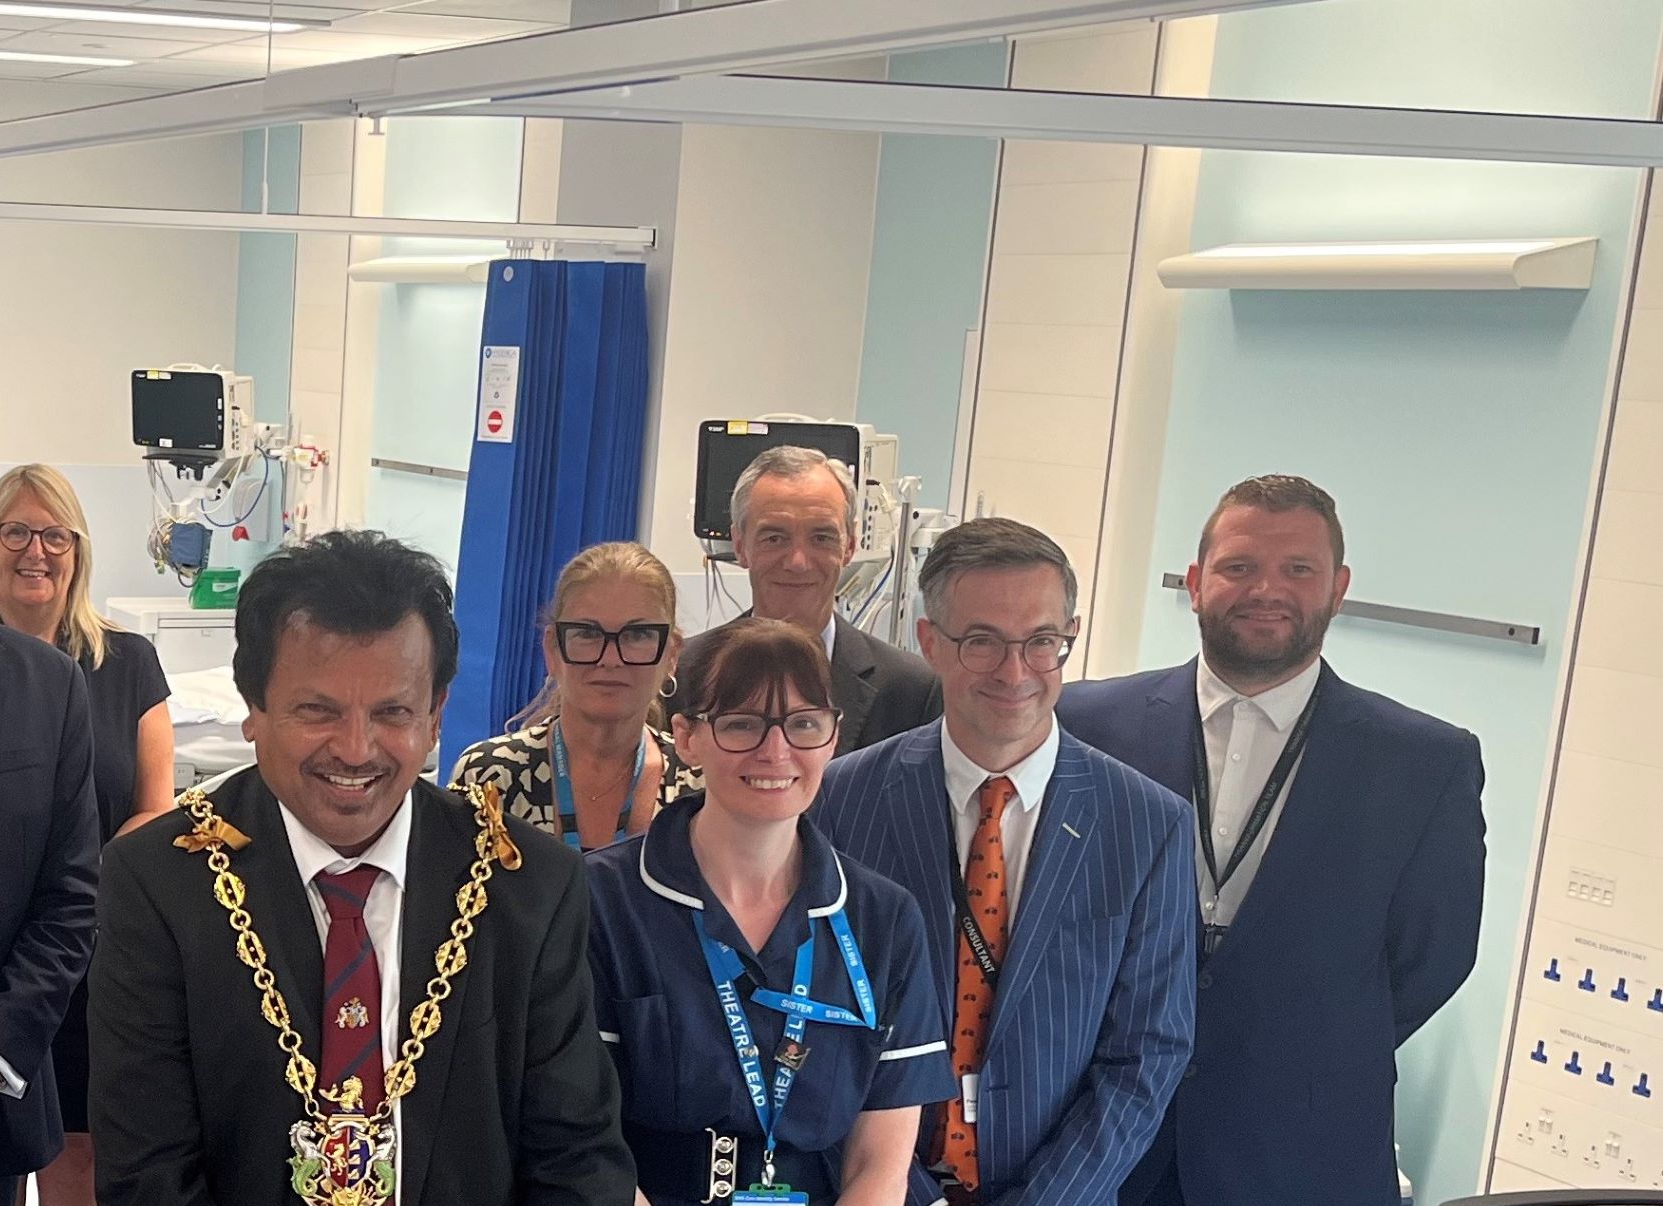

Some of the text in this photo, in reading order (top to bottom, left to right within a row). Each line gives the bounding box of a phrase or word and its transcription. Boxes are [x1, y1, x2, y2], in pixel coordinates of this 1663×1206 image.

[840, 934, 858, 967] SISTER
[962, 916, 995, 973] CONSULTANT
[780, 999, 814, 1014] SISTER
[856, 979, 872, 1013] SISTER
[742, 1060, 767, 1107] LEAD
